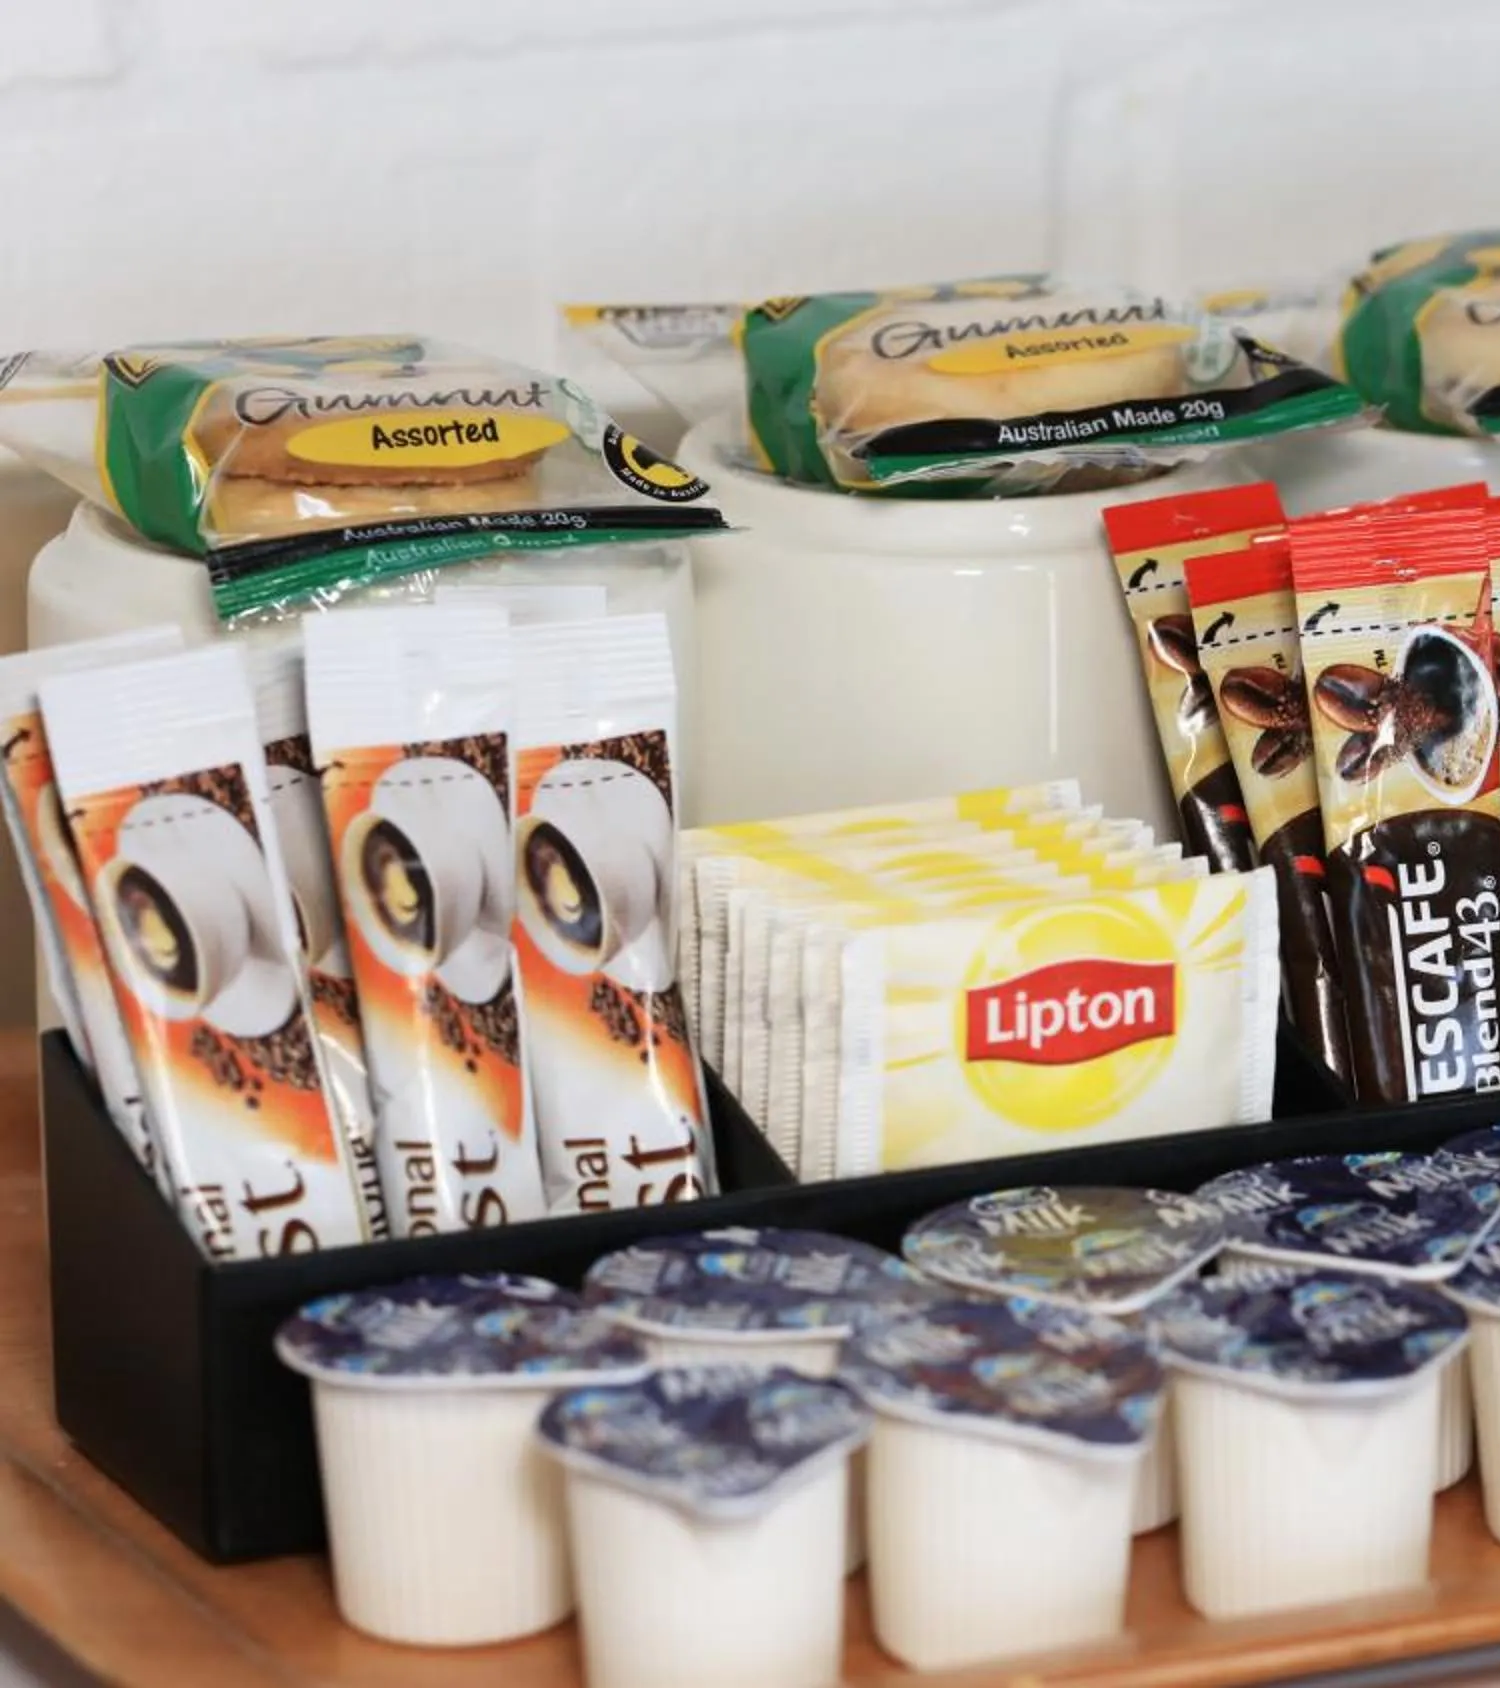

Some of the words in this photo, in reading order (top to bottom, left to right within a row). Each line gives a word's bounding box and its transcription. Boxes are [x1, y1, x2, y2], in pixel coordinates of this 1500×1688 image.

[1005, 331, 1128, 359] Assorted
[372, 417, 499, 450] Assorted
[998, 417, 1108, 444] Australian
[1112, 407, 1177, 429] Made
[1180, 400, 1225, 420] 20g
[342, 519, 463, 541] Australian
[540, 512, 588, 530] 20g
[986, 986, 1155, 1050] Lipton
[978, 1204, 1097, 1237] Milk
